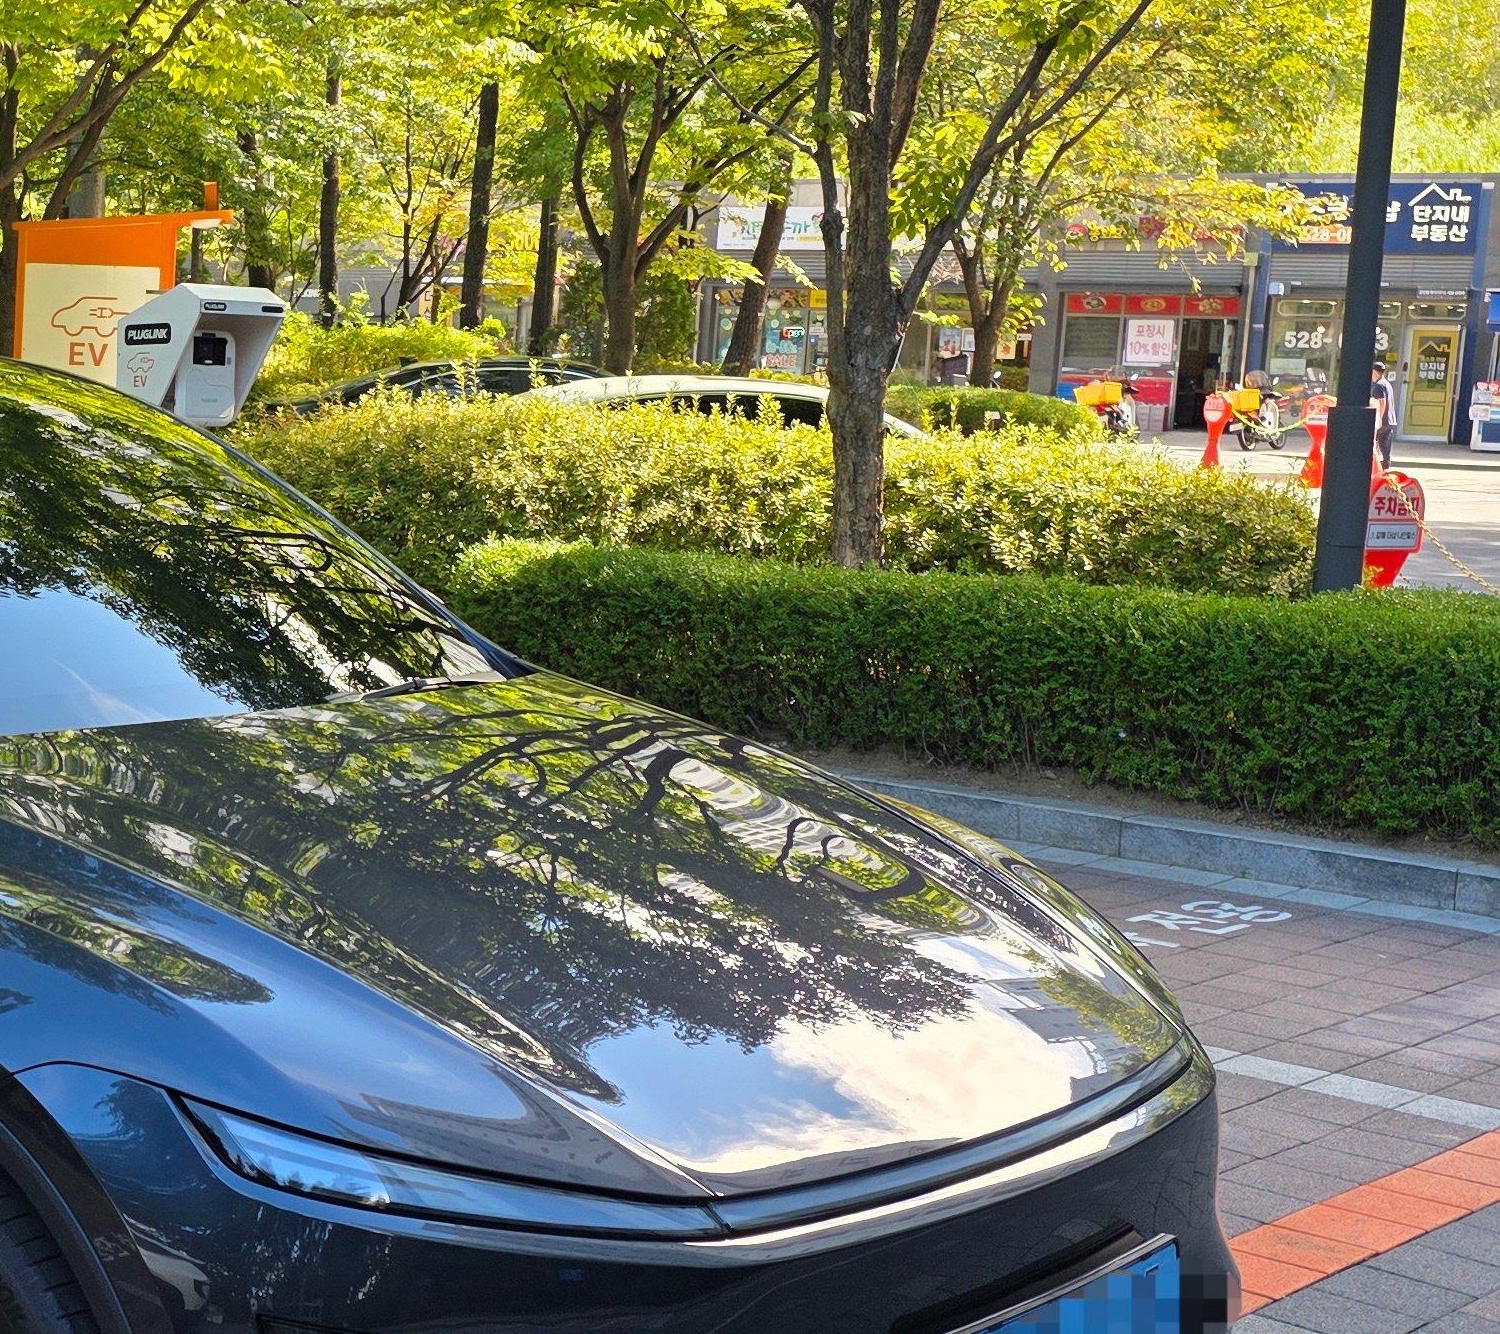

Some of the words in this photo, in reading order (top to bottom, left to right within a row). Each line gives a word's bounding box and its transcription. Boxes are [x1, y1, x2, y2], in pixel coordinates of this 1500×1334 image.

[1413, 205, 1470, 223] 단지내
[1411, 224, 1468, 243] 부동산
[127, 327, 168, 341] PLUGLINK
[1135, 324, 1165, 338] 포장시
[68, 342, 108, 367] EV
[1130, 341, 1149, 355] 10%
[133, 375, 148, 387] EV
